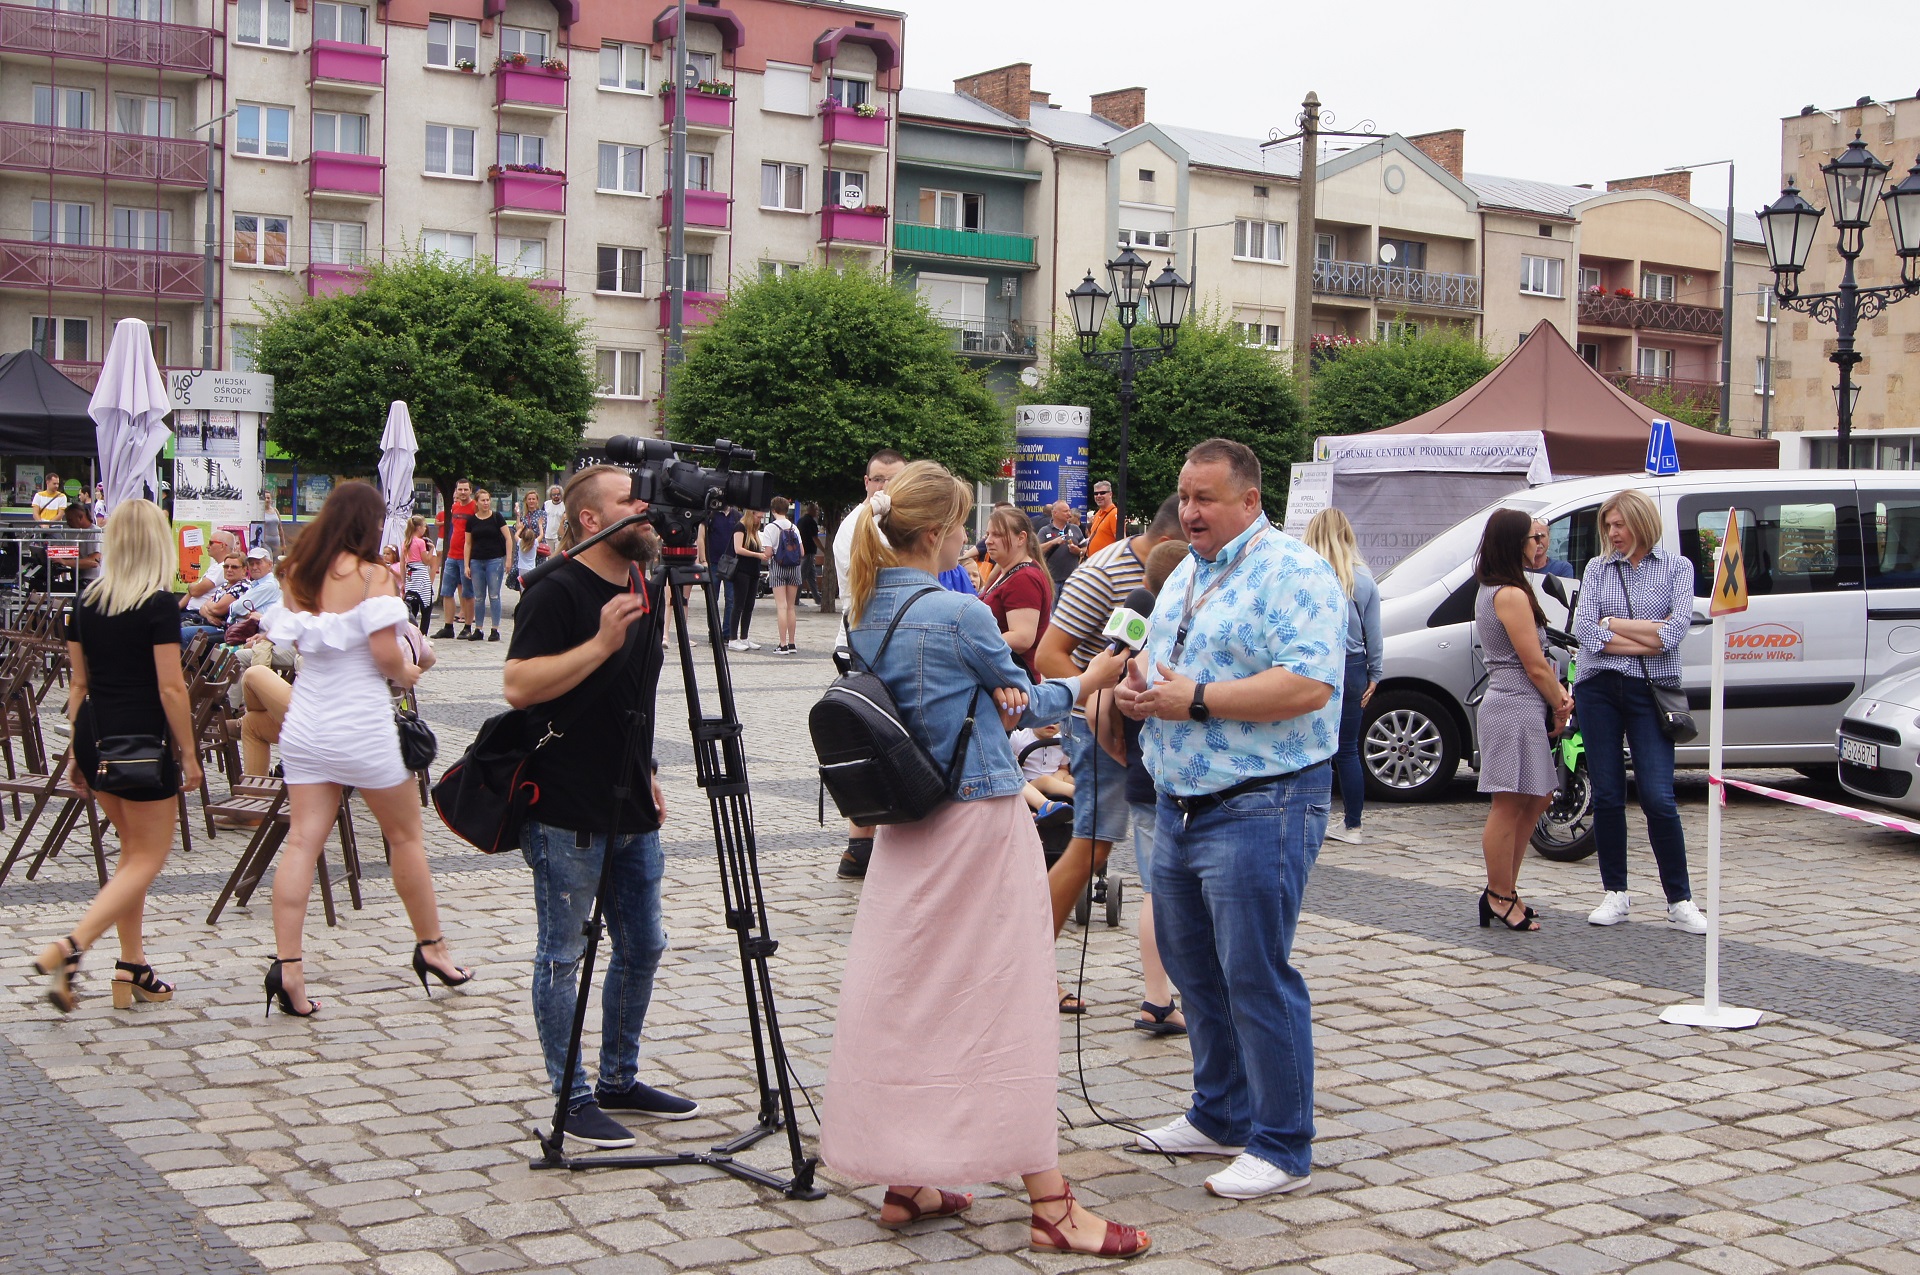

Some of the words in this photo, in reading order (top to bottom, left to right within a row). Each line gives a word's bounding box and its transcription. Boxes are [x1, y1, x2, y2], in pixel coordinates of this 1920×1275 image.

[214, 377, 247, 386] MIEJSKI
[213, 386, 252, 395] OŚRODEK
[1336, 448, 1373, 459] LUBUSKIE
[1376, 446, 1415, 457] CENTRUM
[1420, 446, 1466, 456] PRODUKTU
[1035, 454, 1060, 462] KULTURY
[1128, 622, 1143, 637] LCI
[1728, 634, 1797, 648] WORD
[1724, 651, 1763, 660] Gorzów
[1767, 651, 1796, 661] Wlkp.
